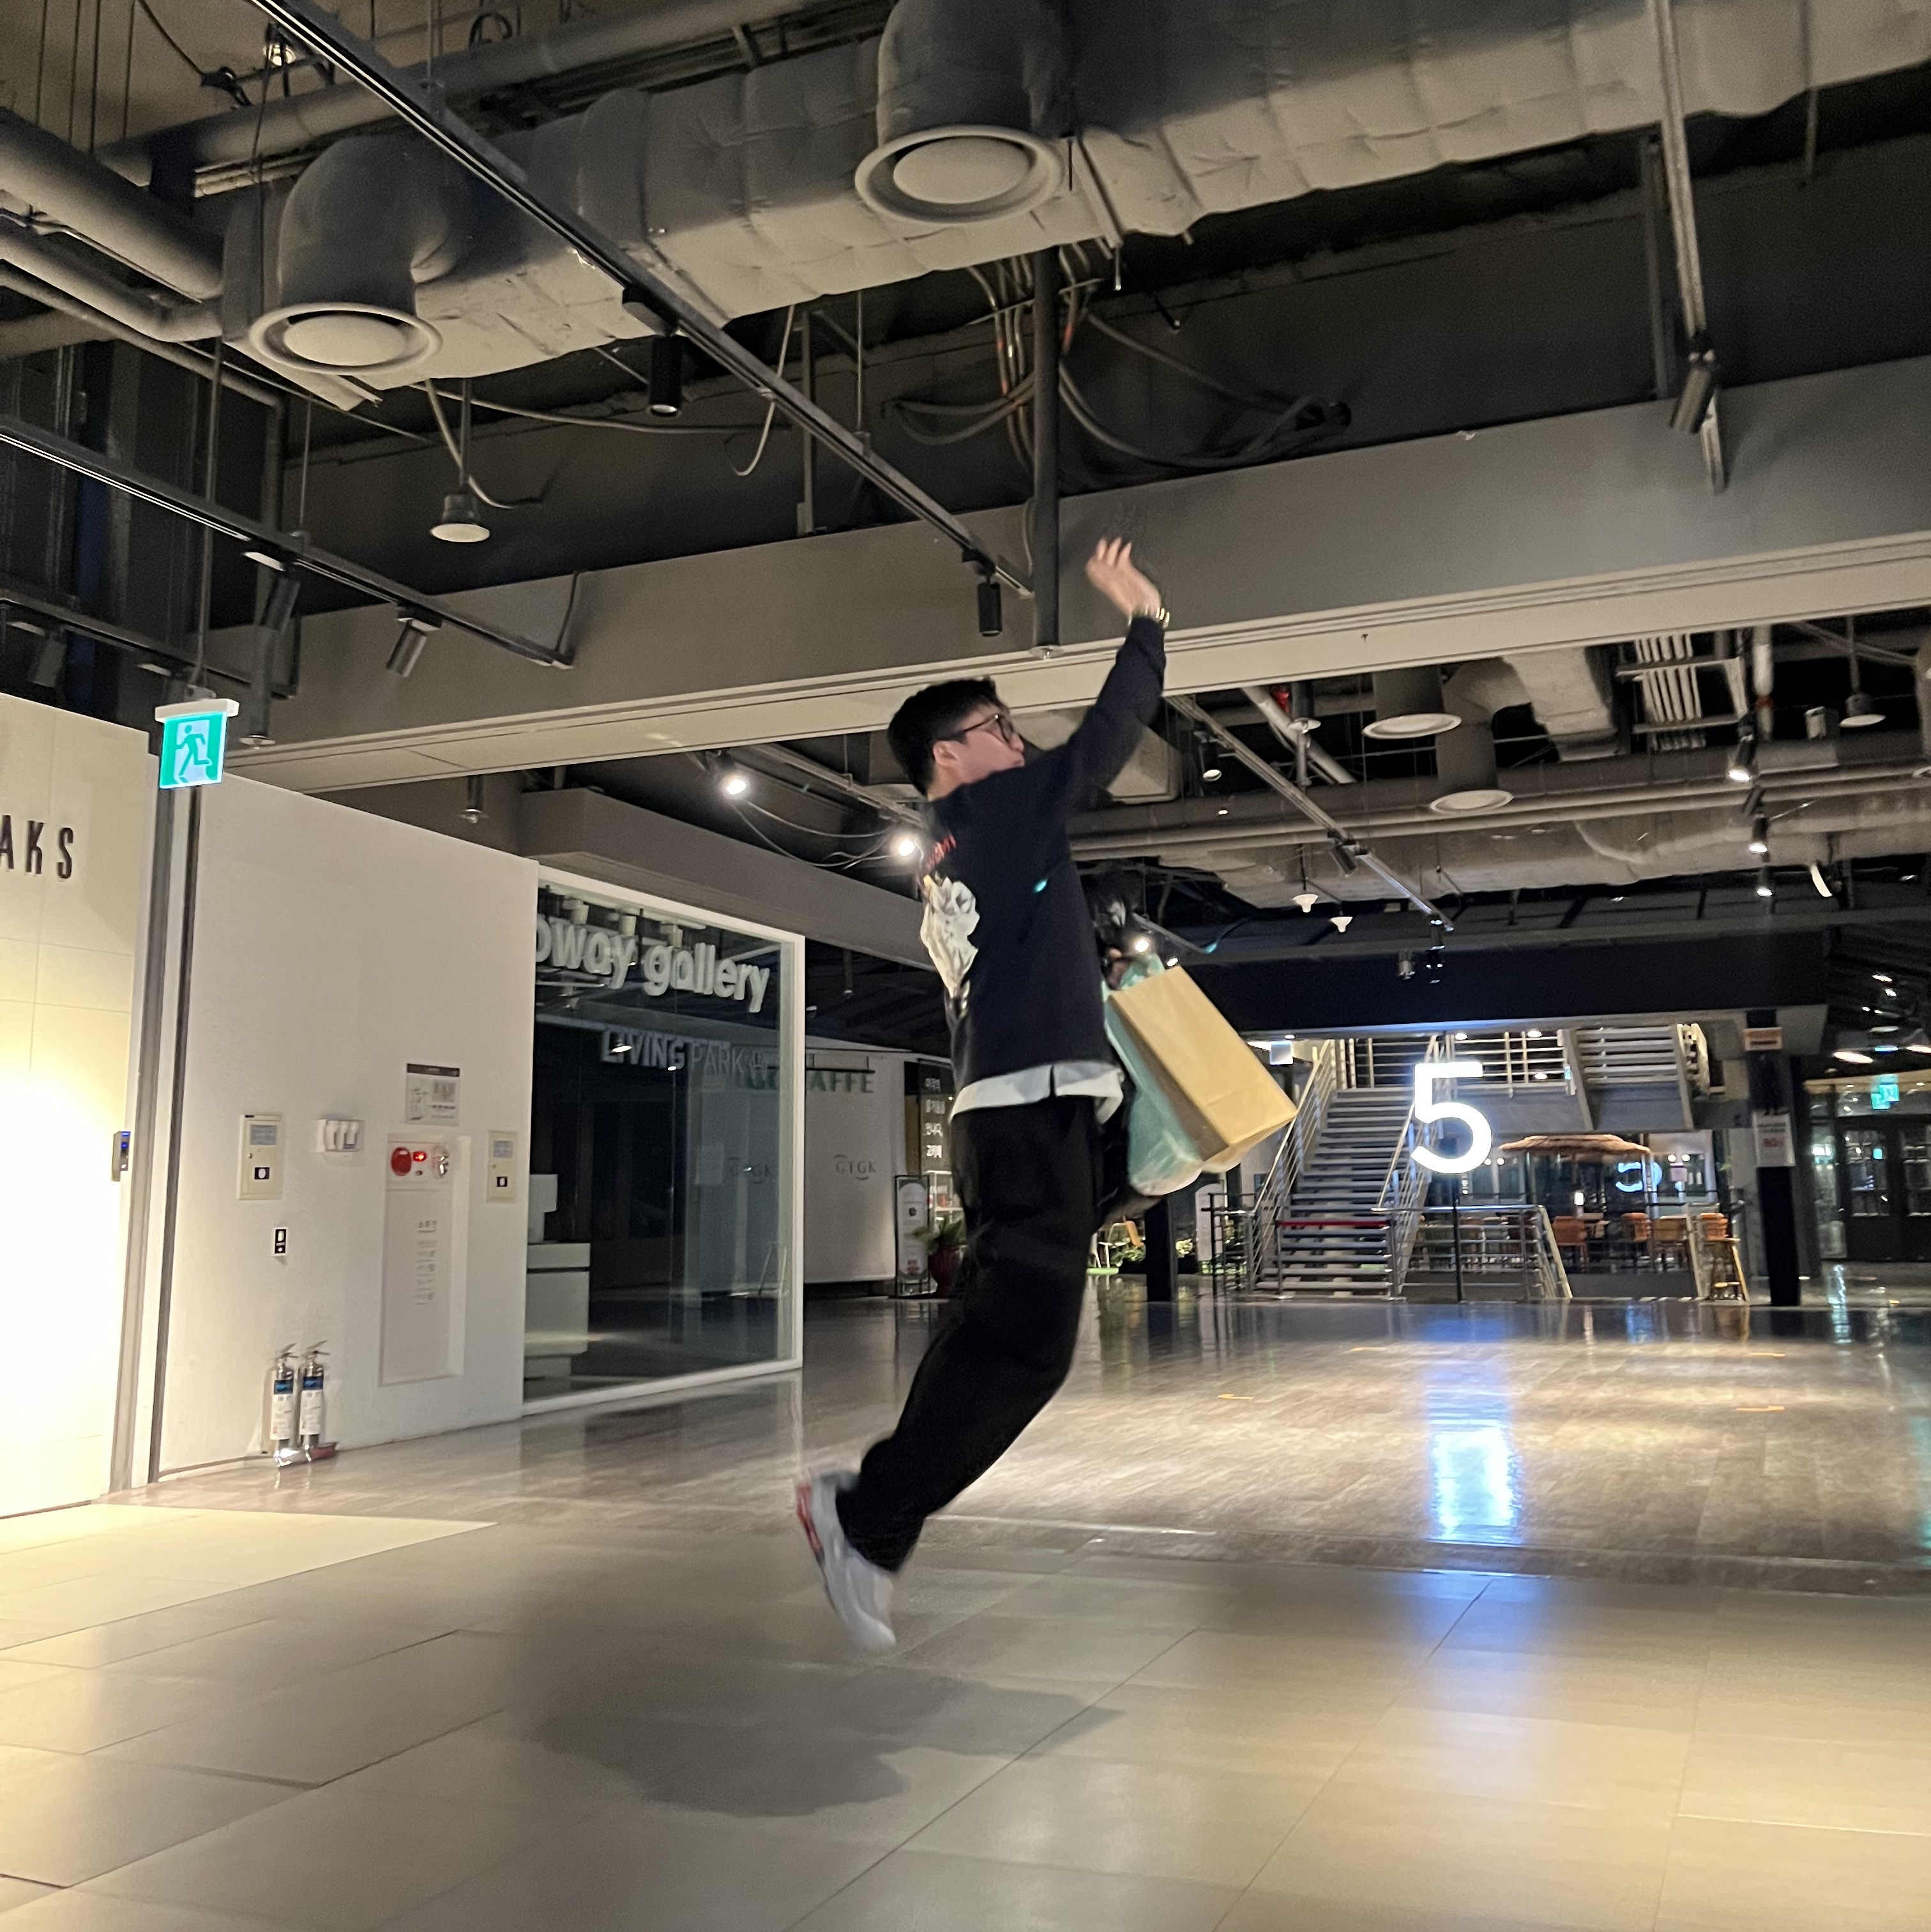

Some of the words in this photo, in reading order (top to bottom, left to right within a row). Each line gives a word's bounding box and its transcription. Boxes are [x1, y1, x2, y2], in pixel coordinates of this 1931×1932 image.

[641, 942, 770, 1013] gallery
[600, 1029, 685, 1070] LIVING
[690, 1042, 744, 1078] PARK
[1410, 1061, 1492, 1174] 5
